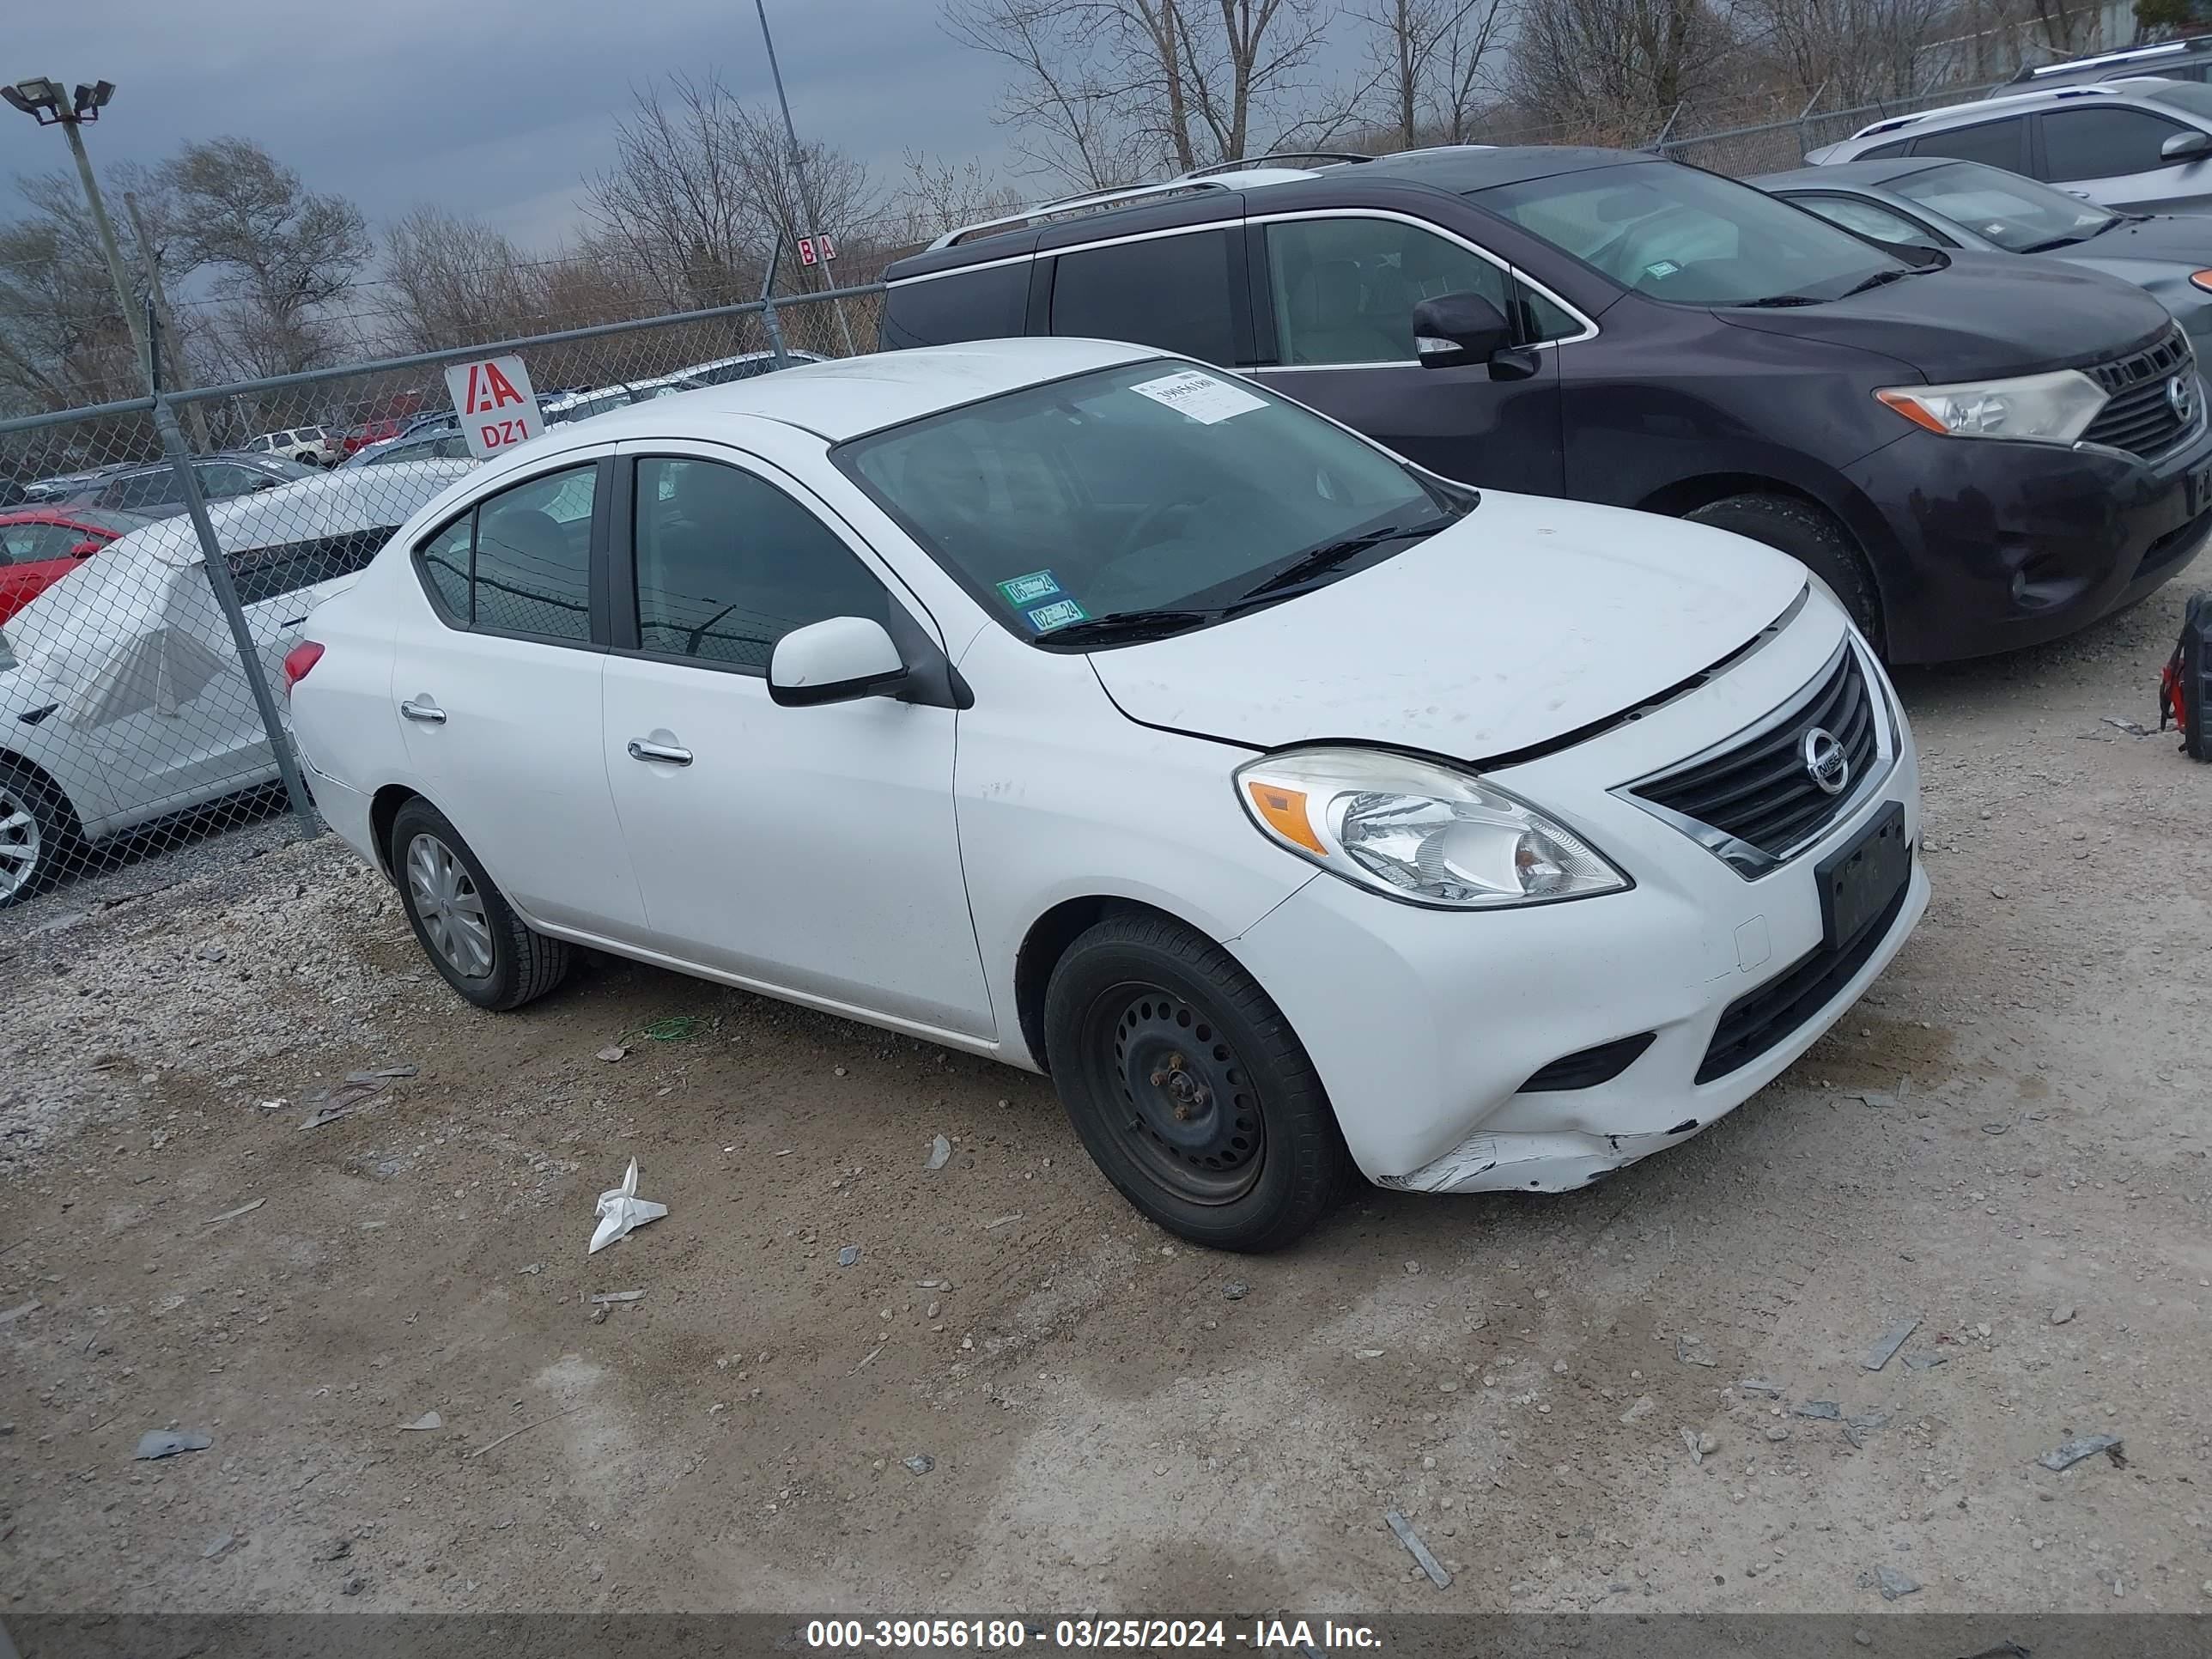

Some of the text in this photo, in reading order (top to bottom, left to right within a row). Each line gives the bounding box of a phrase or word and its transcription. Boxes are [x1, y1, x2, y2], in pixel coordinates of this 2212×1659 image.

[801, 237, 834, 263] B A
[481, 419, 529, 449] DZ1
[1008, 583, 1028, 599] 06
[1817, 746, 1845, 775] NISSA
